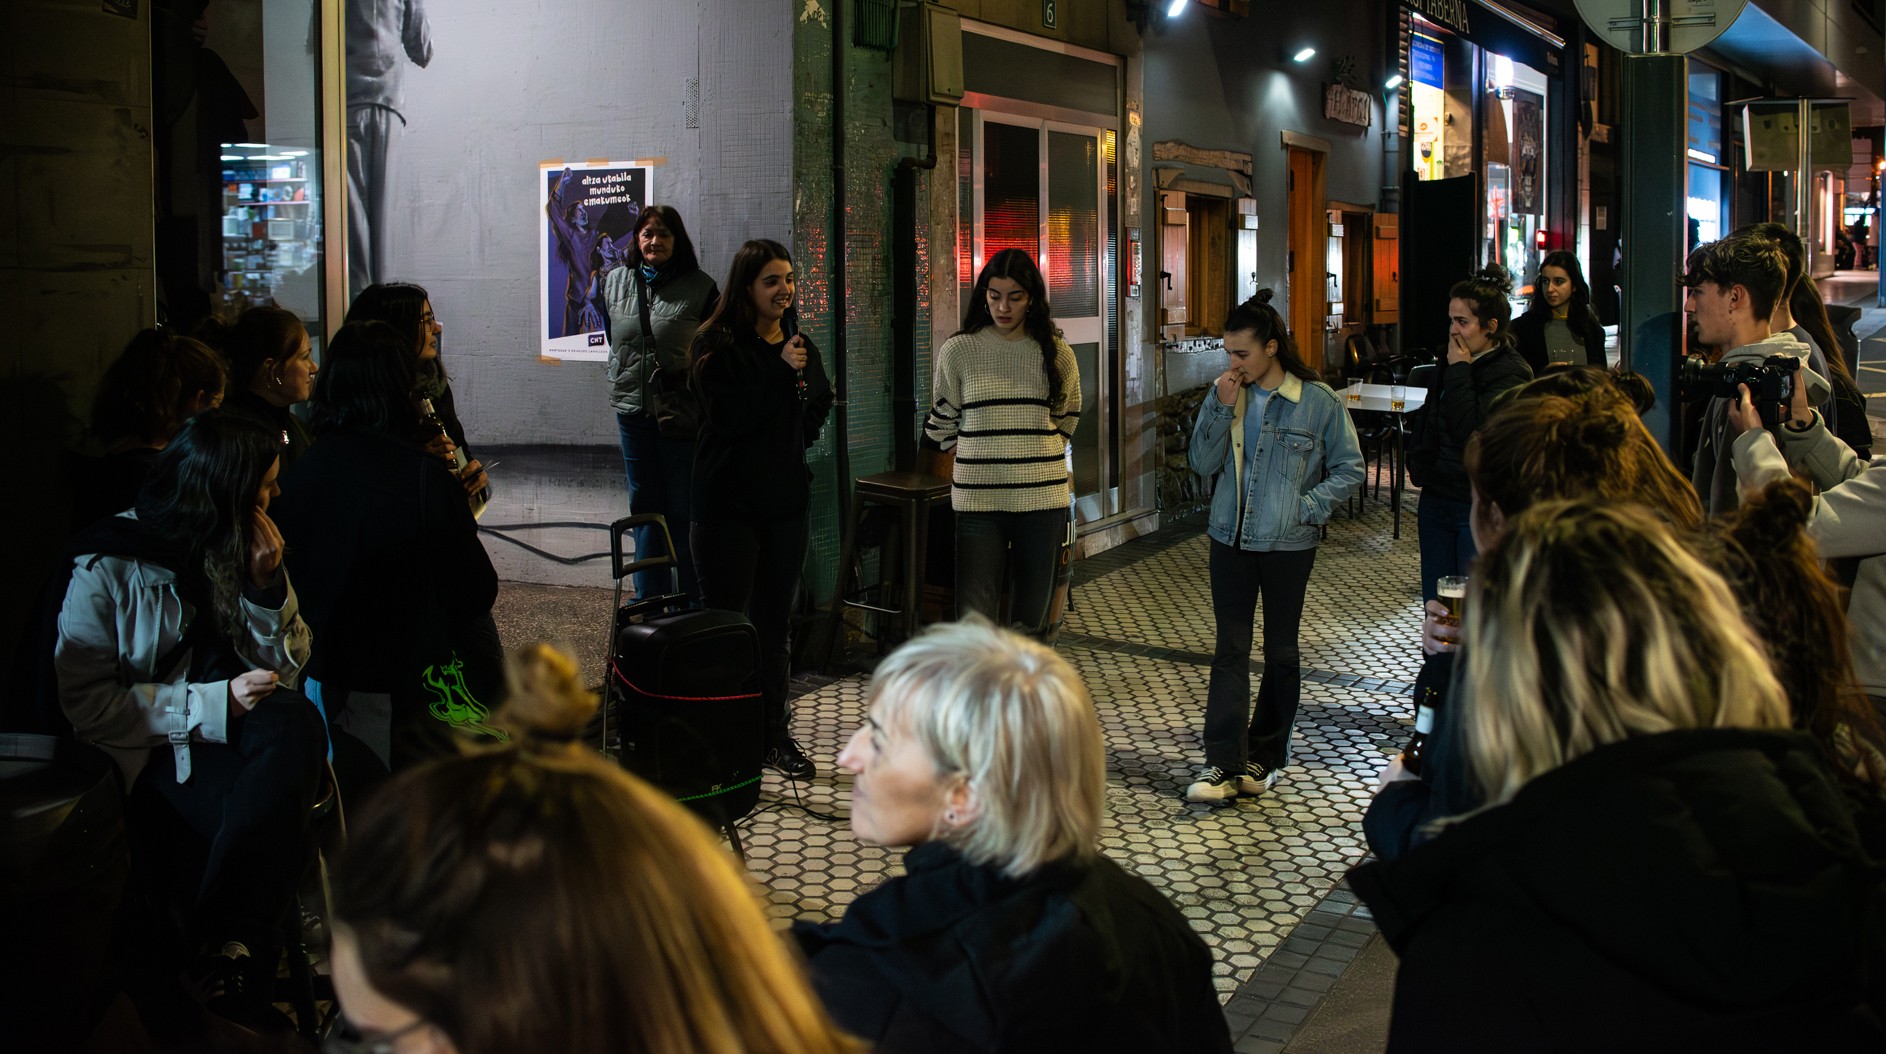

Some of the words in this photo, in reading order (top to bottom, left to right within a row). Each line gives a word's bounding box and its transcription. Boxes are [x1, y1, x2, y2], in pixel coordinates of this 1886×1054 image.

[1046, 3, 1054, 23] 6
[581, 175, 601, 185] altza
[602, 172, 631, 184] ukabila
[589, 184, 625, 195] munduko
[583, 194, 631, 206] emakumeok
